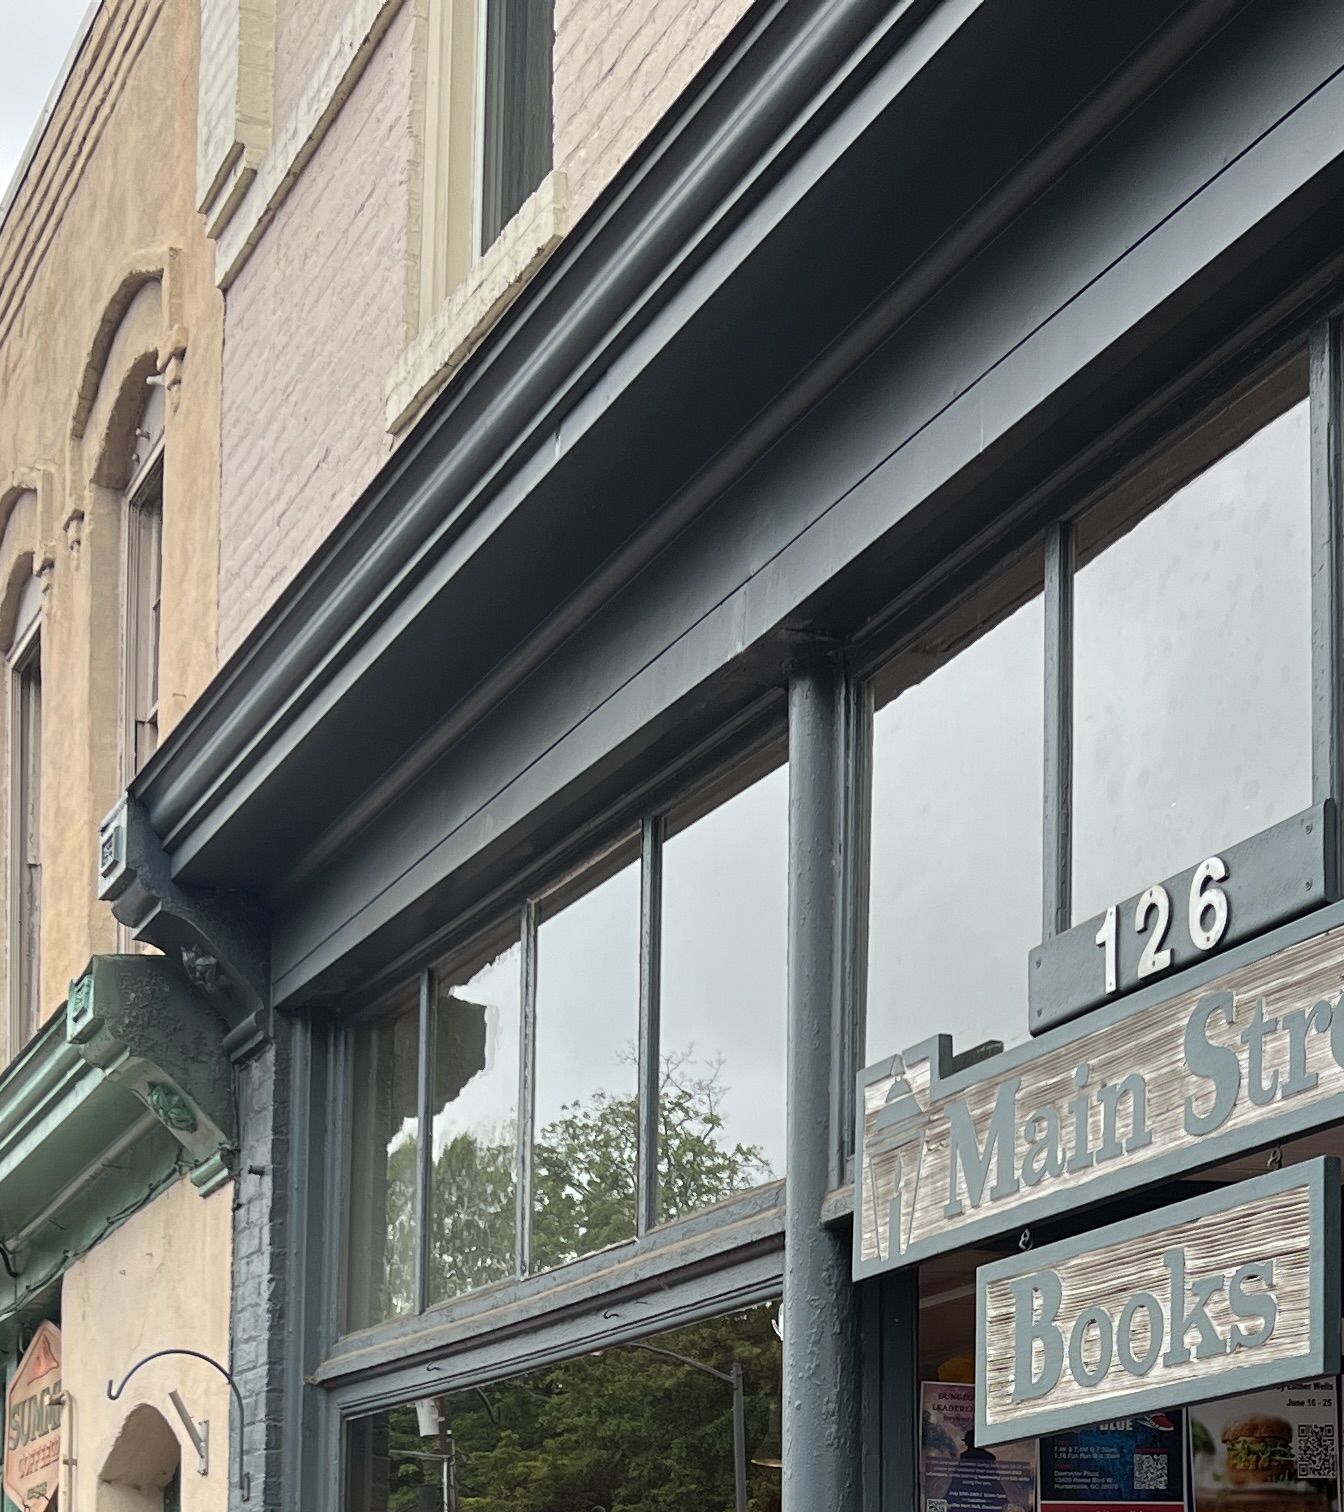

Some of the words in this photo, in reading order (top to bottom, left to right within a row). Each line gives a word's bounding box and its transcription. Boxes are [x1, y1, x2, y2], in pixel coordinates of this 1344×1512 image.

[1095, 854, 1232, 995] 126
[942, 1061, 1154, 1220] Main
[1009, 1246, 1279, 1404] Books
[1314, 1381, 1334, 1391] Wells
[1286, 1399, 1305, 1407] June
[1322, 1399, 1333, 1407] 25
